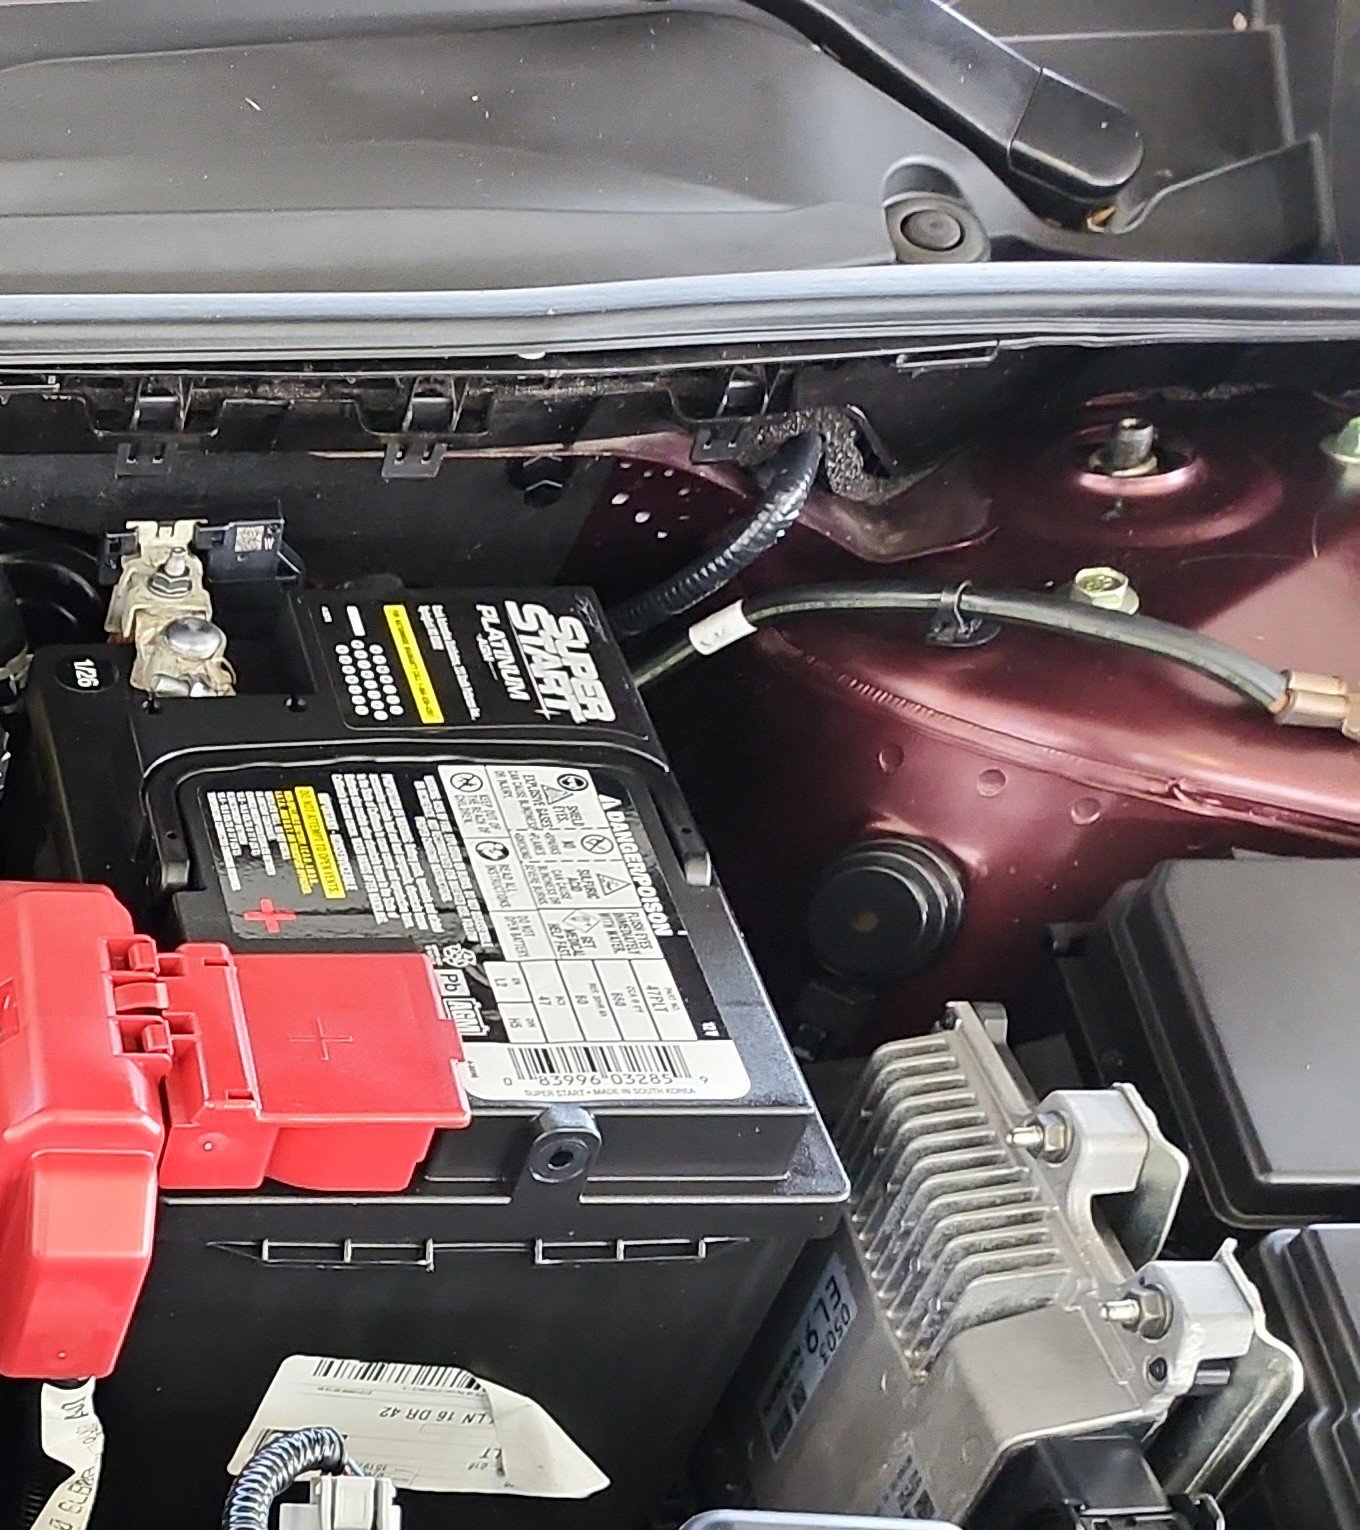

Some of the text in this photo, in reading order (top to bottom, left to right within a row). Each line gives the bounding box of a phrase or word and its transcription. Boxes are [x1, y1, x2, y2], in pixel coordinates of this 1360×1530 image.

[474, 604, 529, 700] PLATINUM
[503, 600, 587, 724] START
[74, 658, 100, 689] 1/26
[544, 614, 619, 722] SUPER
[301, 800, 314, 812] NOT
[305, 814, 324, 842] ATTEMPT
[317, 853, 332, 869] OPEN
[604, 810, 672, 936] DANGER/POISON
[576, 869, 599, 899] SULFURIC
[612, 912, 639, 954] IMMEDIATELY
[440, 974, 462, 991] Pb
[493, 978, 508, 987] L2
[537, 996, 551, 1005] 47
[645, 985, 667, 1012] 47PLT
[447, 1001, 480, 1032] AGM
[507, 1018, 522, 1028] H5
[503, 1073, 709, 1086] 0 83996 03285 9
[379, 1405, 454, 1423] 16 DR 42
